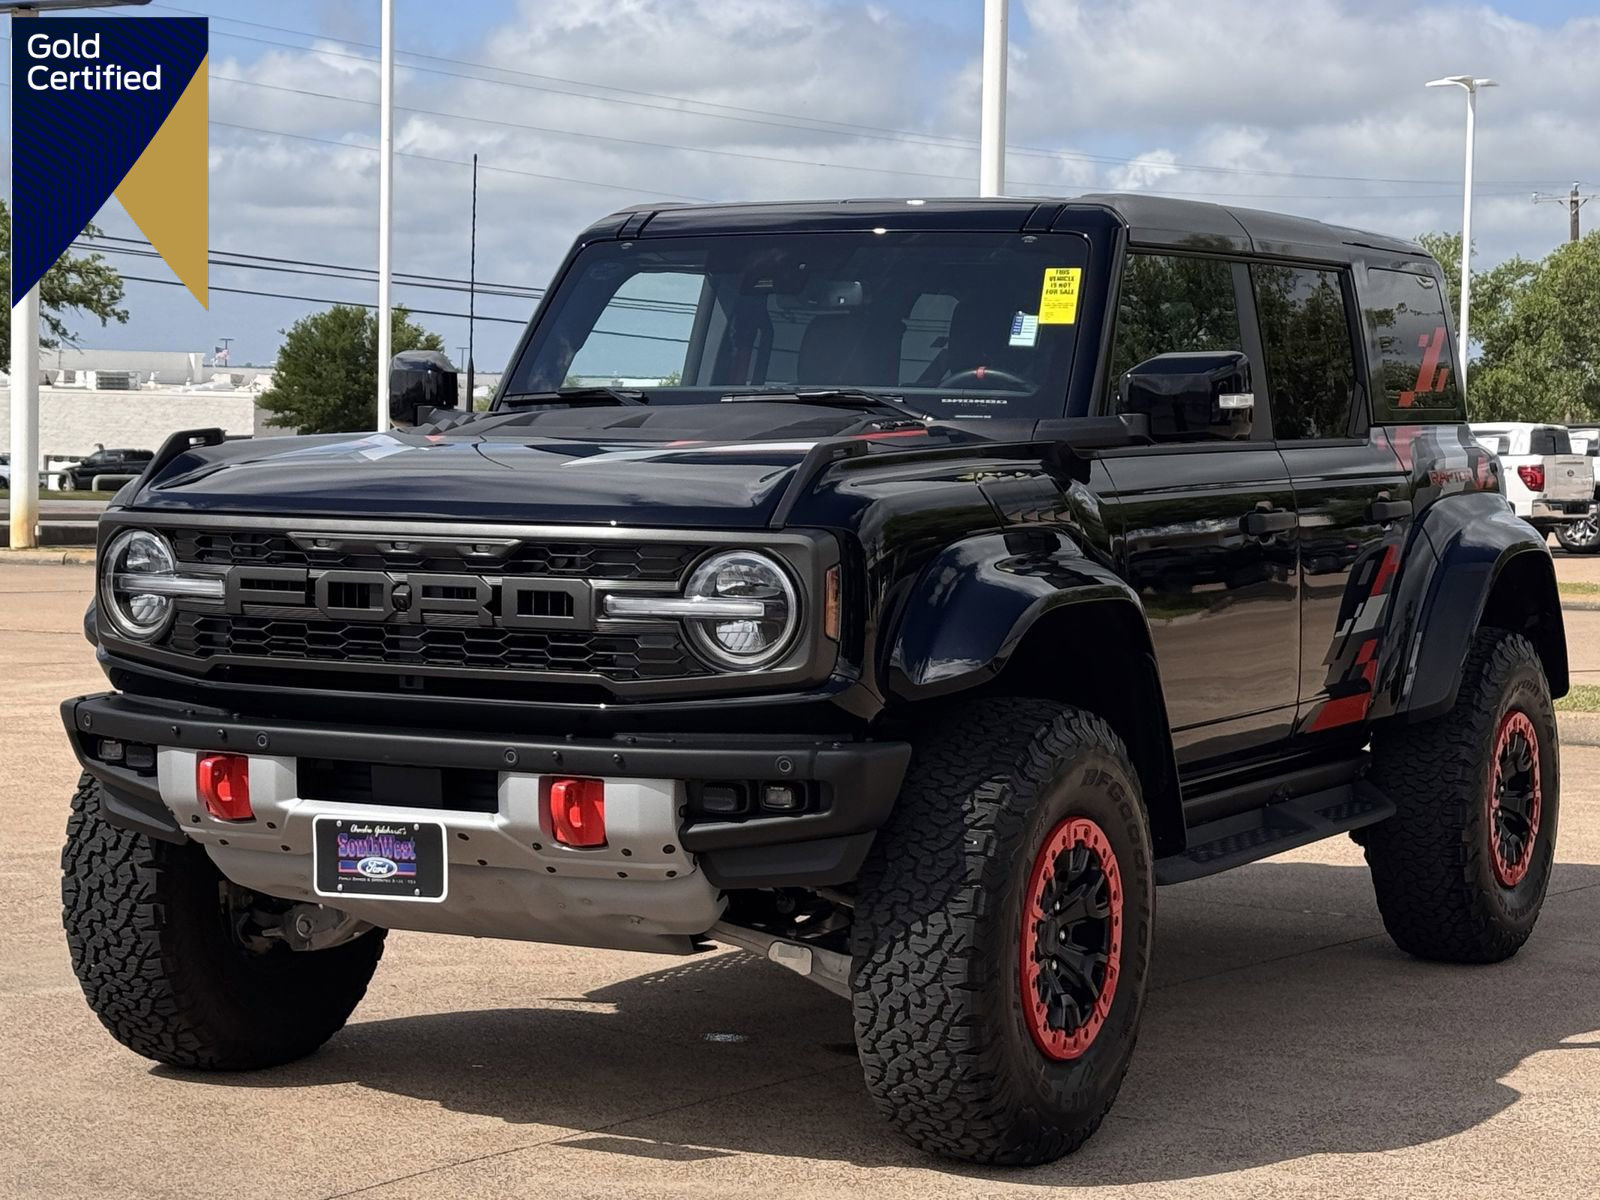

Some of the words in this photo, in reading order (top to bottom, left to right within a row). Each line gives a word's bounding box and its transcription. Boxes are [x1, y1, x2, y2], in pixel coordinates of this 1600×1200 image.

[226, 566, 594, 632] FORD
[337, 832, 417, 860] SouthWest
[365, 860, 389, 874] Ford
